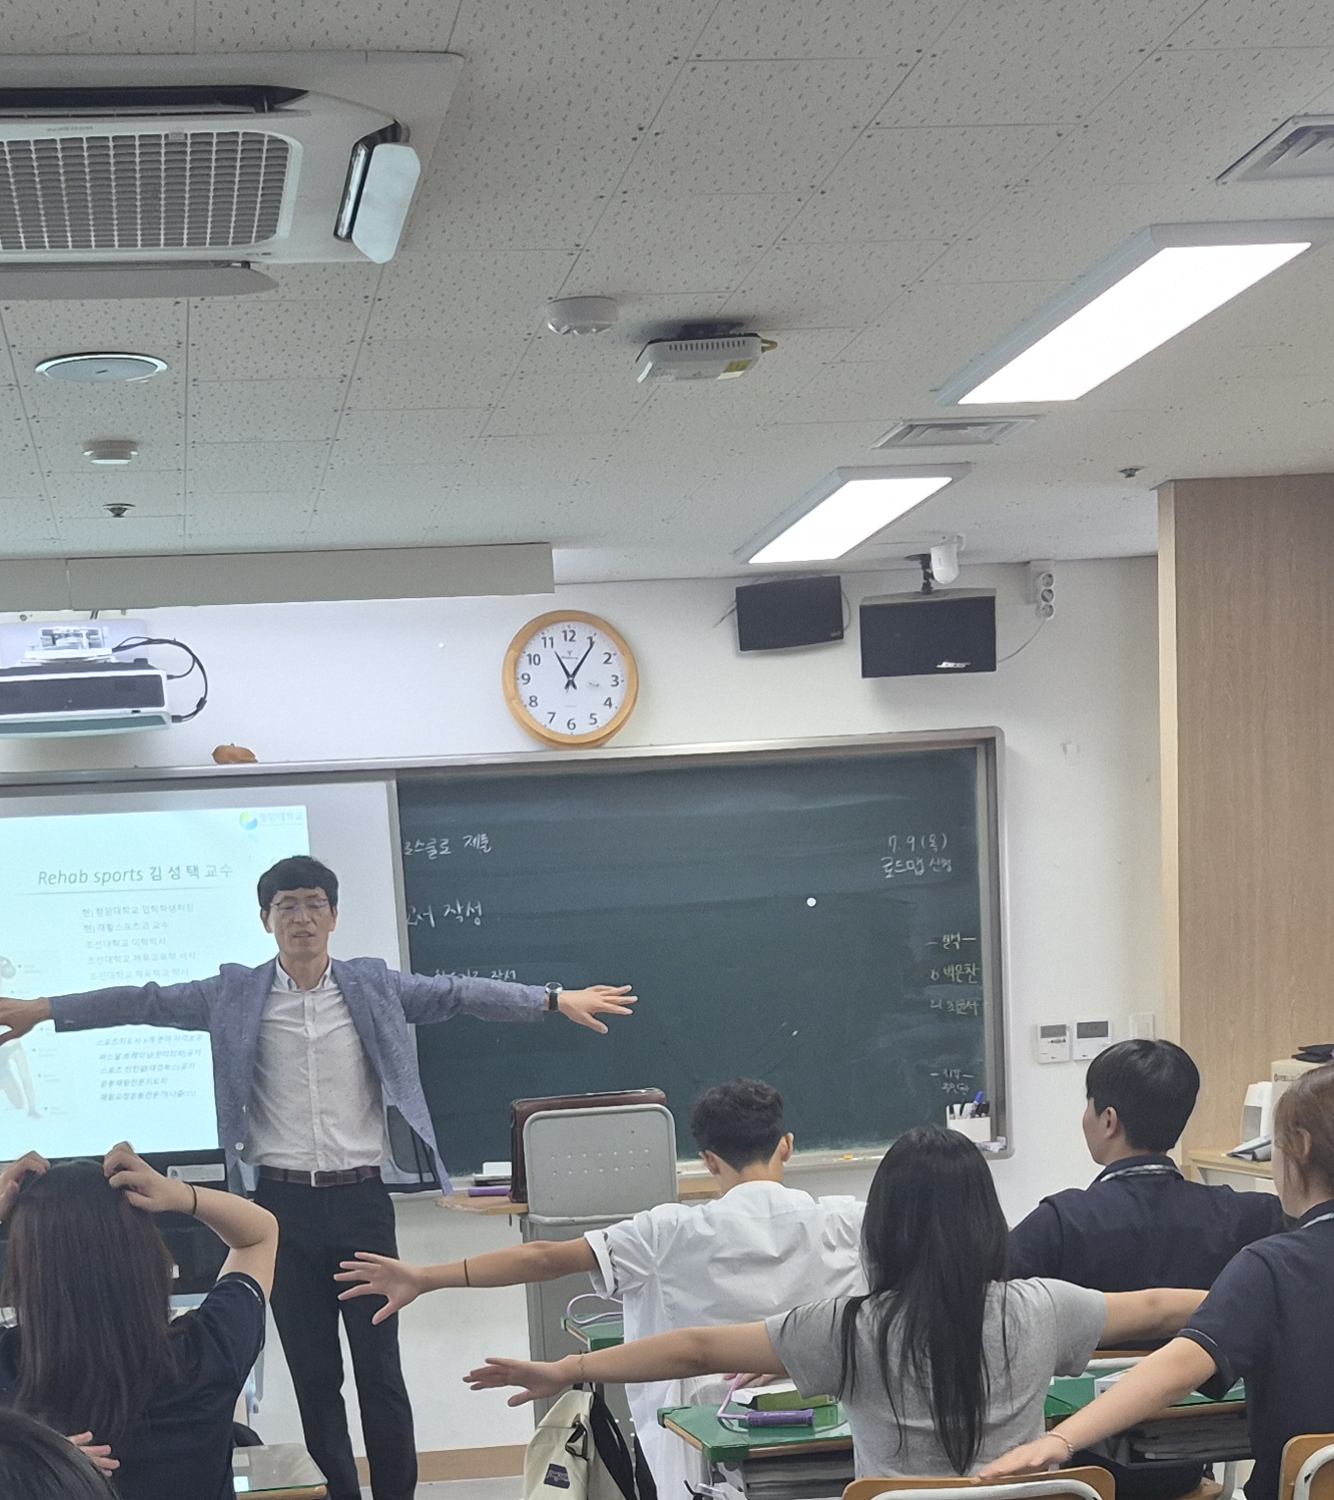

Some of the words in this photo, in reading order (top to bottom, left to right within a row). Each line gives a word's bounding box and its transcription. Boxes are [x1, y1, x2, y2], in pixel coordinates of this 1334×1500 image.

[38, 870, 89, 886] Rehab
[93, 868, 144, 886] sports
[443, 899, 483, 926] 작성
